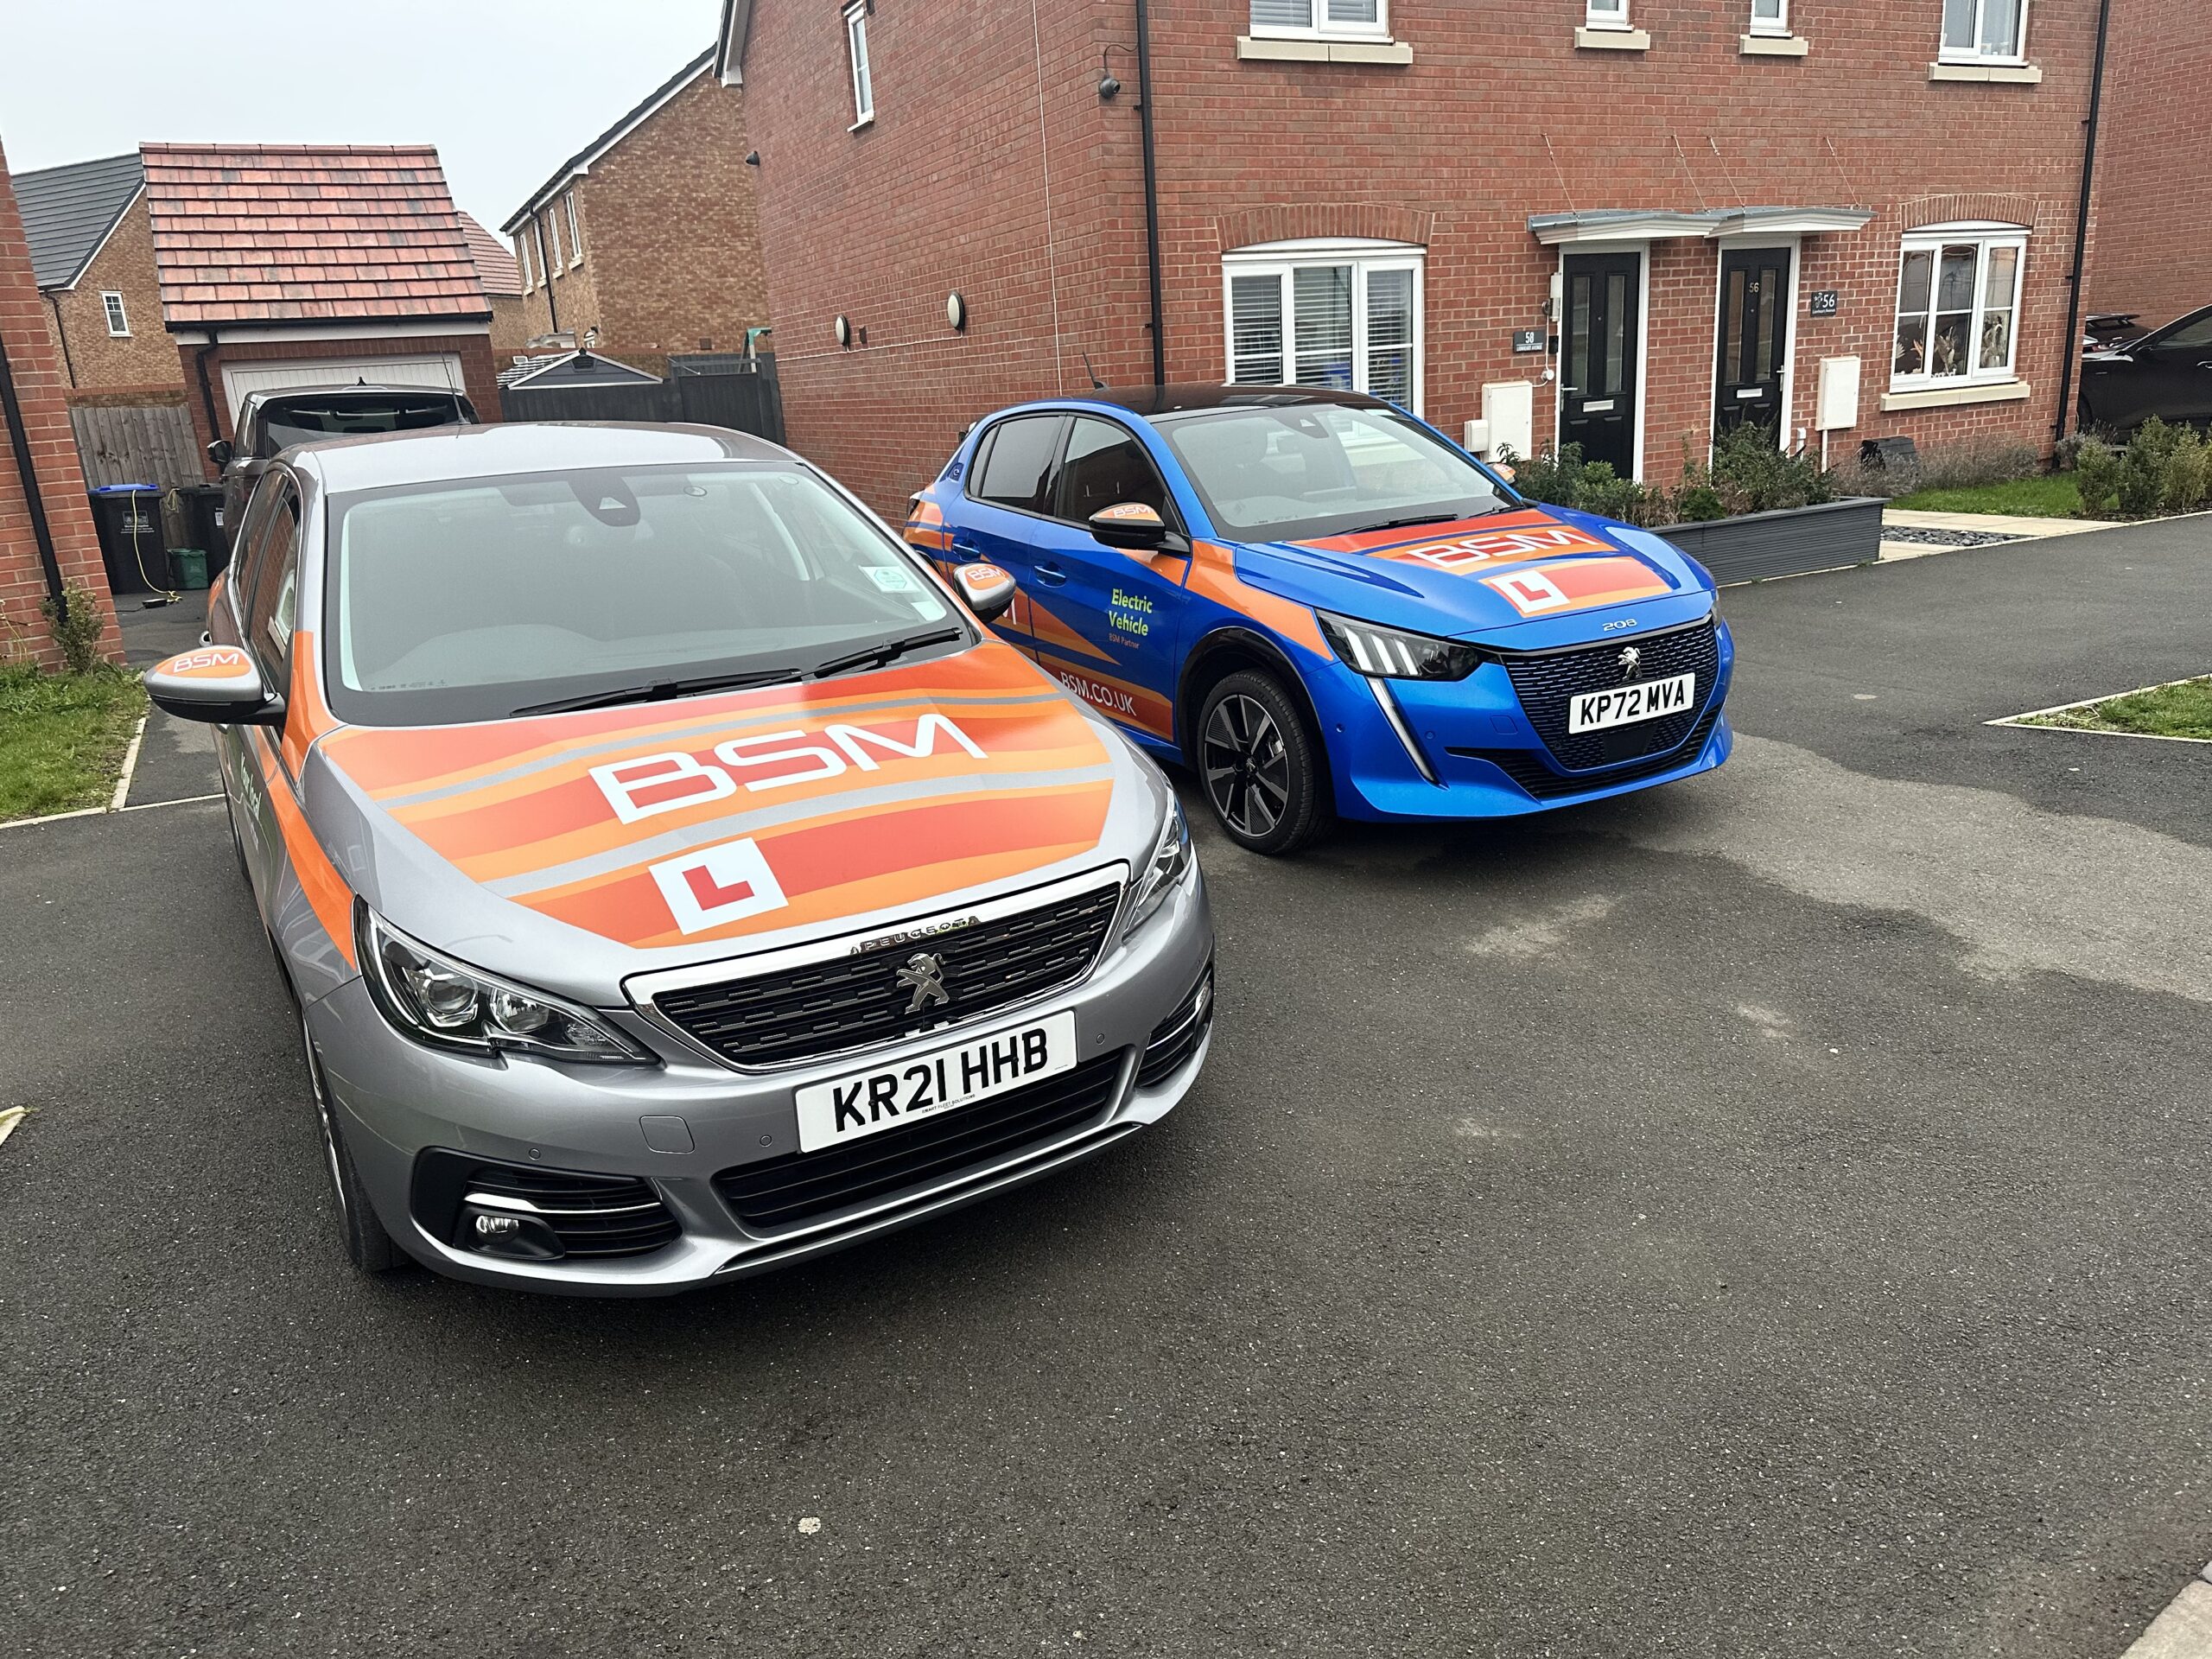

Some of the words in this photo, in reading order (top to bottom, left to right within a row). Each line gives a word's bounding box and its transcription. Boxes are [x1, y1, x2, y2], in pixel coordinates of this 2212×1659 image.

[1749, 282, 1759, 293] 56
[1822, 294, 1835, 308] 56
[1525, 331, 1535, 344] 58
[1113, 505, 1151, 518] BSM
[1406, 530, 1599, 568] BSM
[967, 565, 1006, 582] BSM
[1111, 588, 1154, 613] Electric
[1509, 580, 1552, 602] L
[1109, 610, 1148, 636] Vehicle
[1601, 618, 1638, 632] 208
[174, 652, 239, 673] BSM
[1060, 671, 1137, 716] BSM.CO.UK
[1580, 689, 1641, 726] KP72
[1646, 679, 1685, 713] MVA
[588, 713, 989, 825] BSM
[682, 855, 755, 911] L
[864, 918, 966, 950] PEUGEOT
[832, 1058, 948, 1133] KR21
[960, 1027, 1048, 1095] HHB
[921, 1105, 938, 1114] SMART
[951, 1093, 976, 1105] SOLUTIONS
